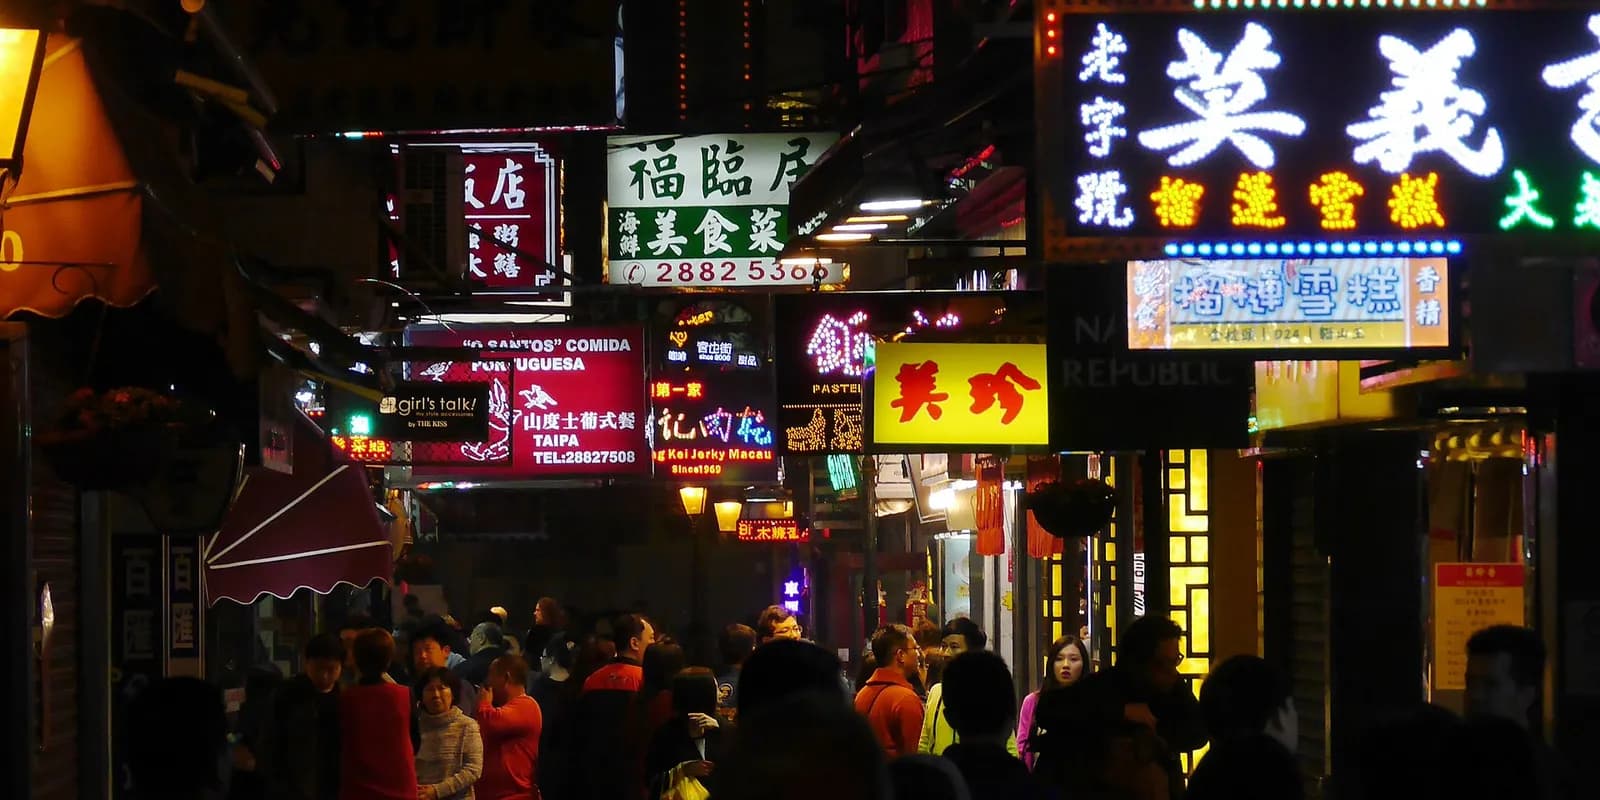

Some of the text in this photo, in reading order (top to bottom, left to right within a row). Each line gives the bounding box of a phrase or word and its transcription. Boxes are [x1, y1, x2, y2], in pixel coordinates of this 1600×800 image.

[1138, 14, 1600, 176] 莫義
[1076, 23, 1134, 228] 老字號
[617, 211, 640, 258] 海鮮
[647, 207, 785, 256] 美食菜
[656, 262, 737, 282] 2882
[1415, 265, 1441, 327] 香精
[565, 339, 631, 352] COMIDA
[471, 357, 585, 372] PORUGUESA
[1062, 357, 1232, 388] REPUBLIC
[651, 382, 702, 398] 第一家
[398, 396, 477, 416] girl's talk!
[432, 420, 448, 428] KISS
[523, 411, 636, 430] 山度士葡式餐
[533, 433, 579, 447] TAIPA
[533, 450, 636, 464] TEL:28827508
[690, 449, 725, 461] Jerky
[728, 449, 772, 459] Macau
